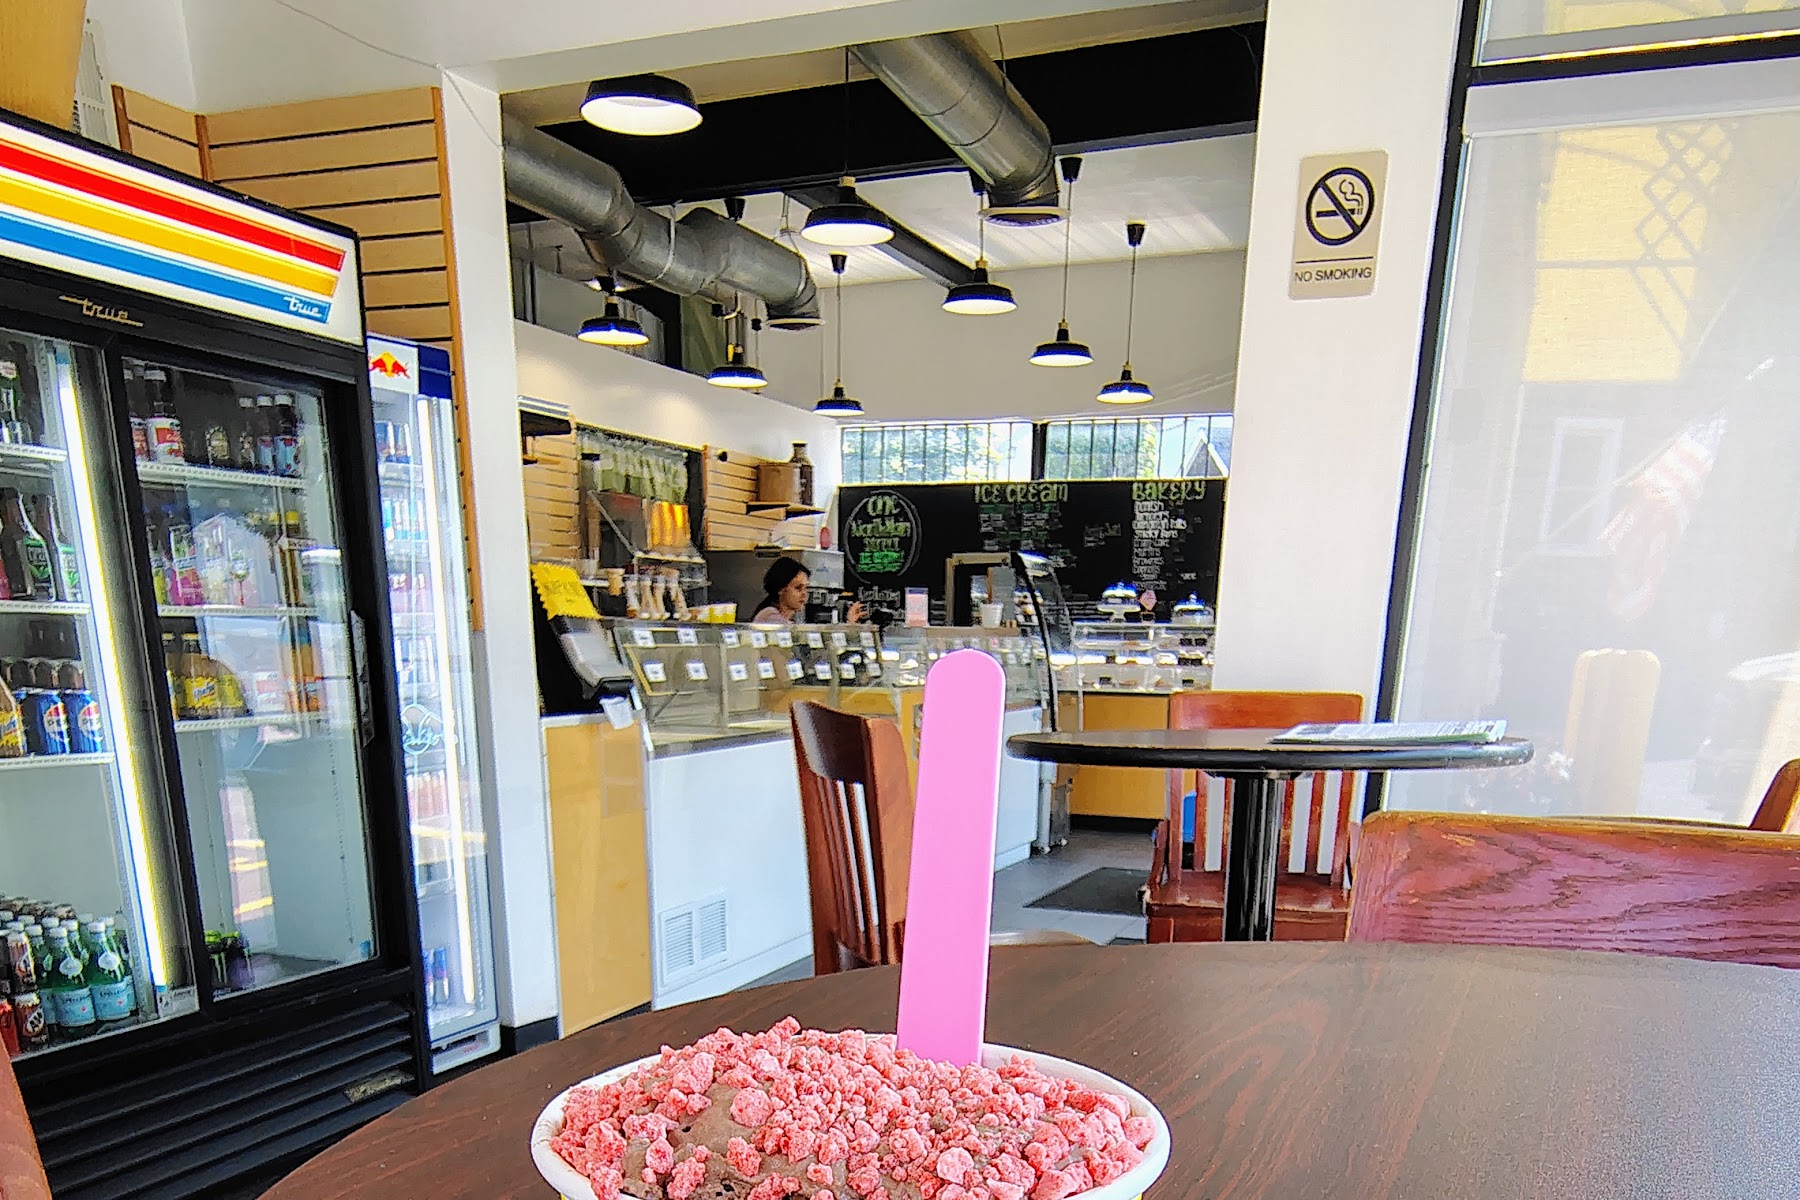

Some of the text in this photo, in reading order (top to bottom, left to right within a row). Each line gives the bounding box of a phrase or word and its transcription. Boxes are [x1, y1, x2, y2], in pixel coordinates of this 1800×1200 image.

[1294, 266, 1373, 282] NO SMOKING
[59, 295, 143, 328] true
[283, 296, 323, 318] true
[973, 484, 1001, 503] ICE
